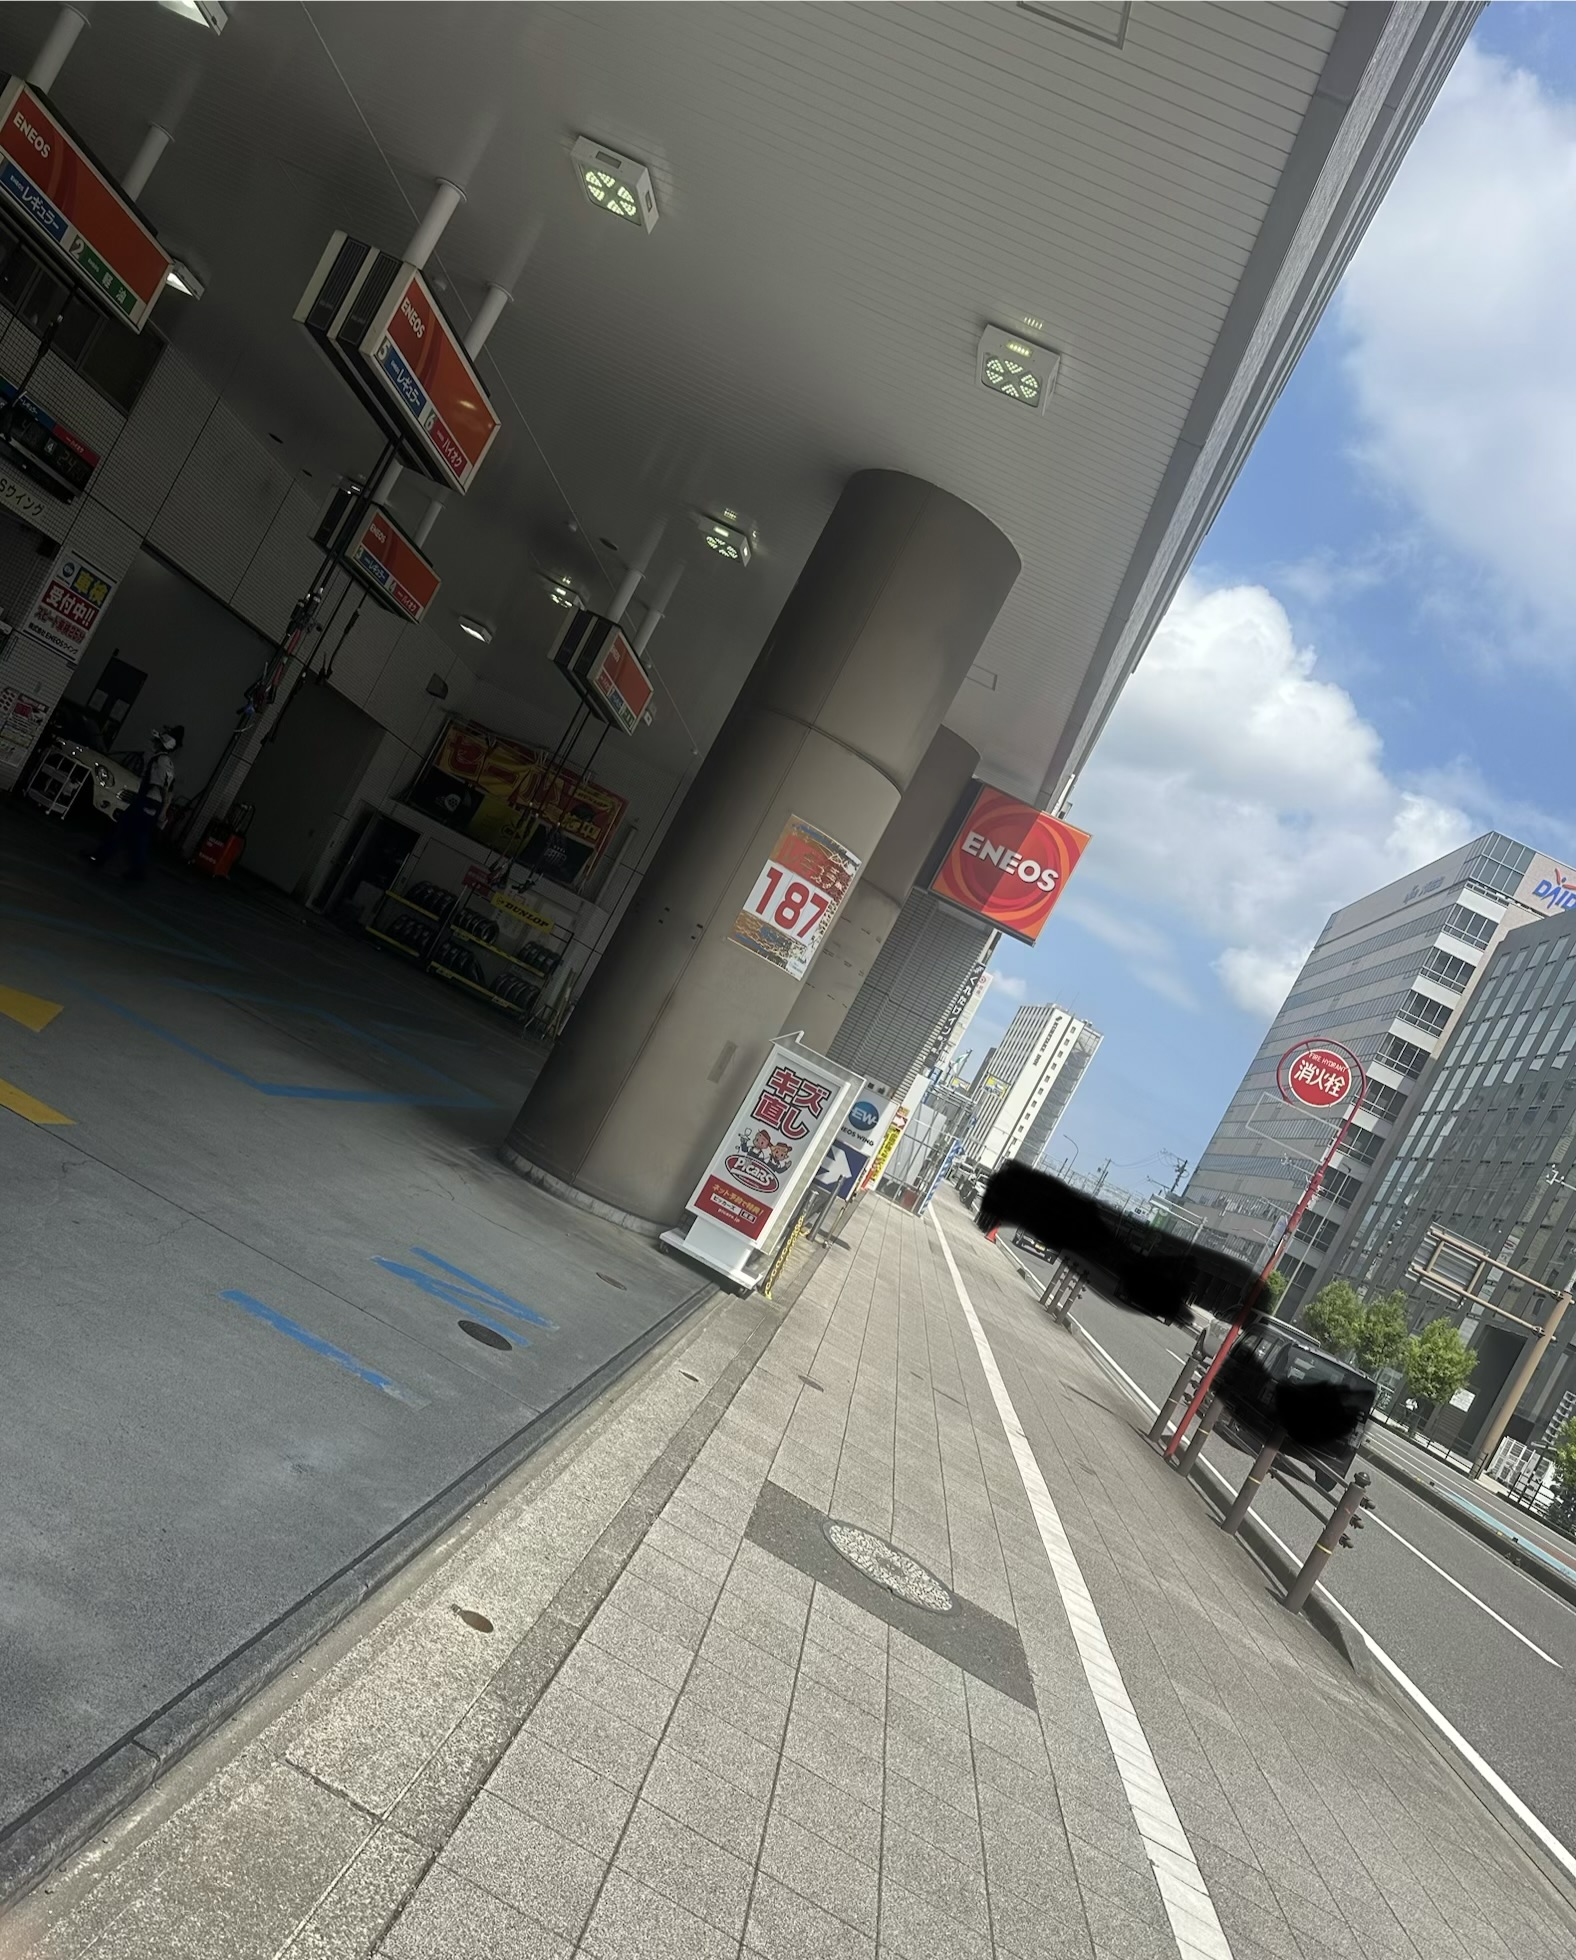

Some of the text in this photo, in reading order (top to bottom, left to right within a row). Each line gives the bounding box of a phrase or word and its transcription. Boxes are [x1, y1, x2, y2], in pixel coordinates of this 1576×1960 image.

[13, 111, 52, 159] ENEOS
[22, 186, 60, 230] レギュラー
[70, 239, 85, 260] 2
[400, 297, 425, 339] ENEOS
[377, 341, 422, 407] 5 レギュラー
[425, 412, 463, 468] 6 ハイオク
[369, 523, 387, 544] ENEOS
[961, 831, 1059, 892] ENEOS
[505, 901, 549, 928] DUNLOP
[755, 867, 829, 938] 187
[1294, 1060, 1345, 1098] 消火栓
[1308, 1052, 1347, 1073] FIRE HYDRANT
[750, 1089, 809, 1140] 直し
[767, 1067, 831, 1119] キズ
